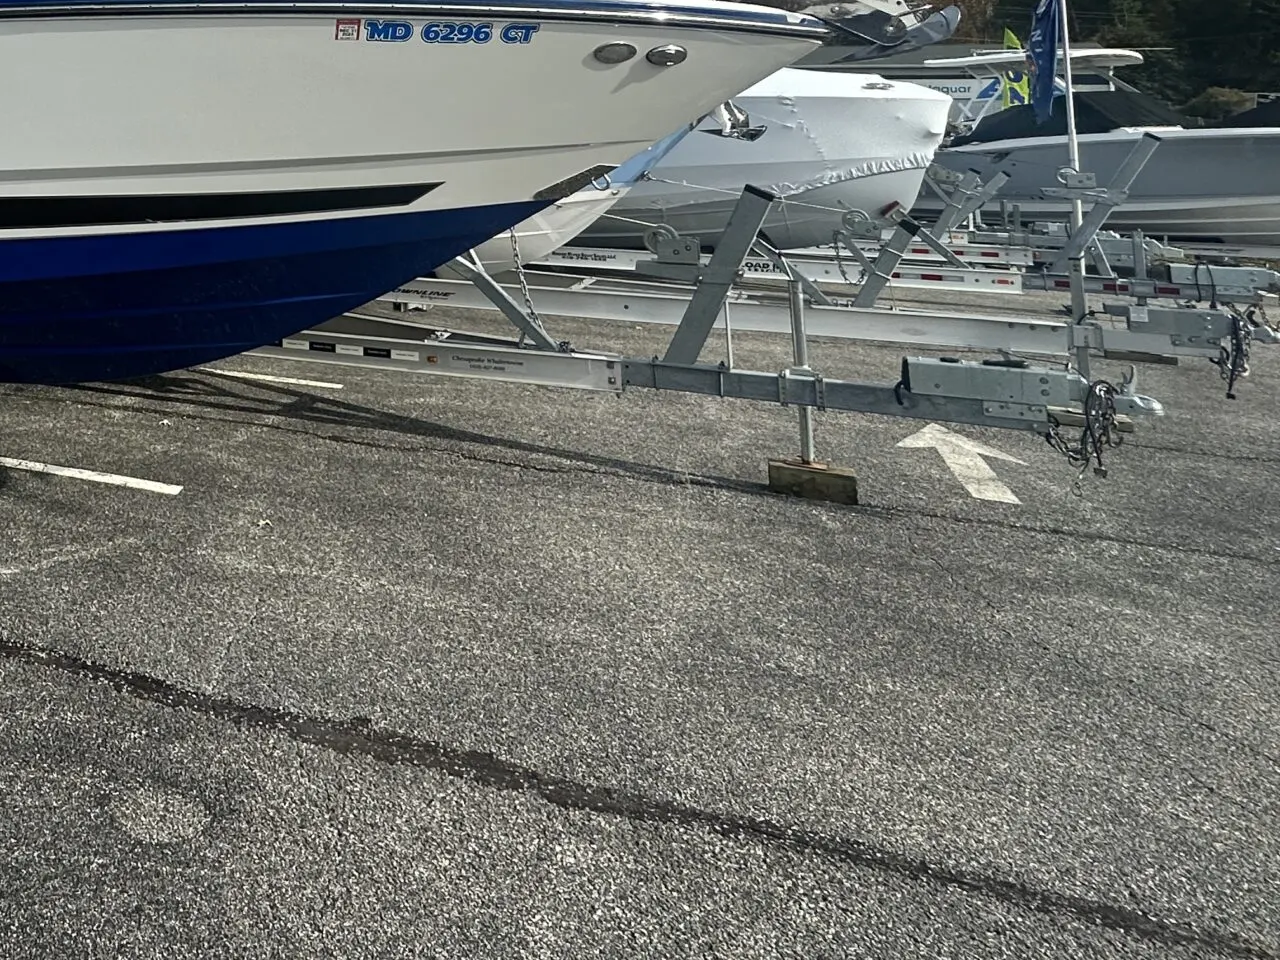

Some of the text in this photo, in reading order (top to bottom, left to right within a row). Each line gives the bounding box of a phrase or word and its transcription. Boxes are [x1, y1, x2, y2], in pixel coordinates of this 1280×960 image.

[364, 19, 541, 44] MD 6296 CT
